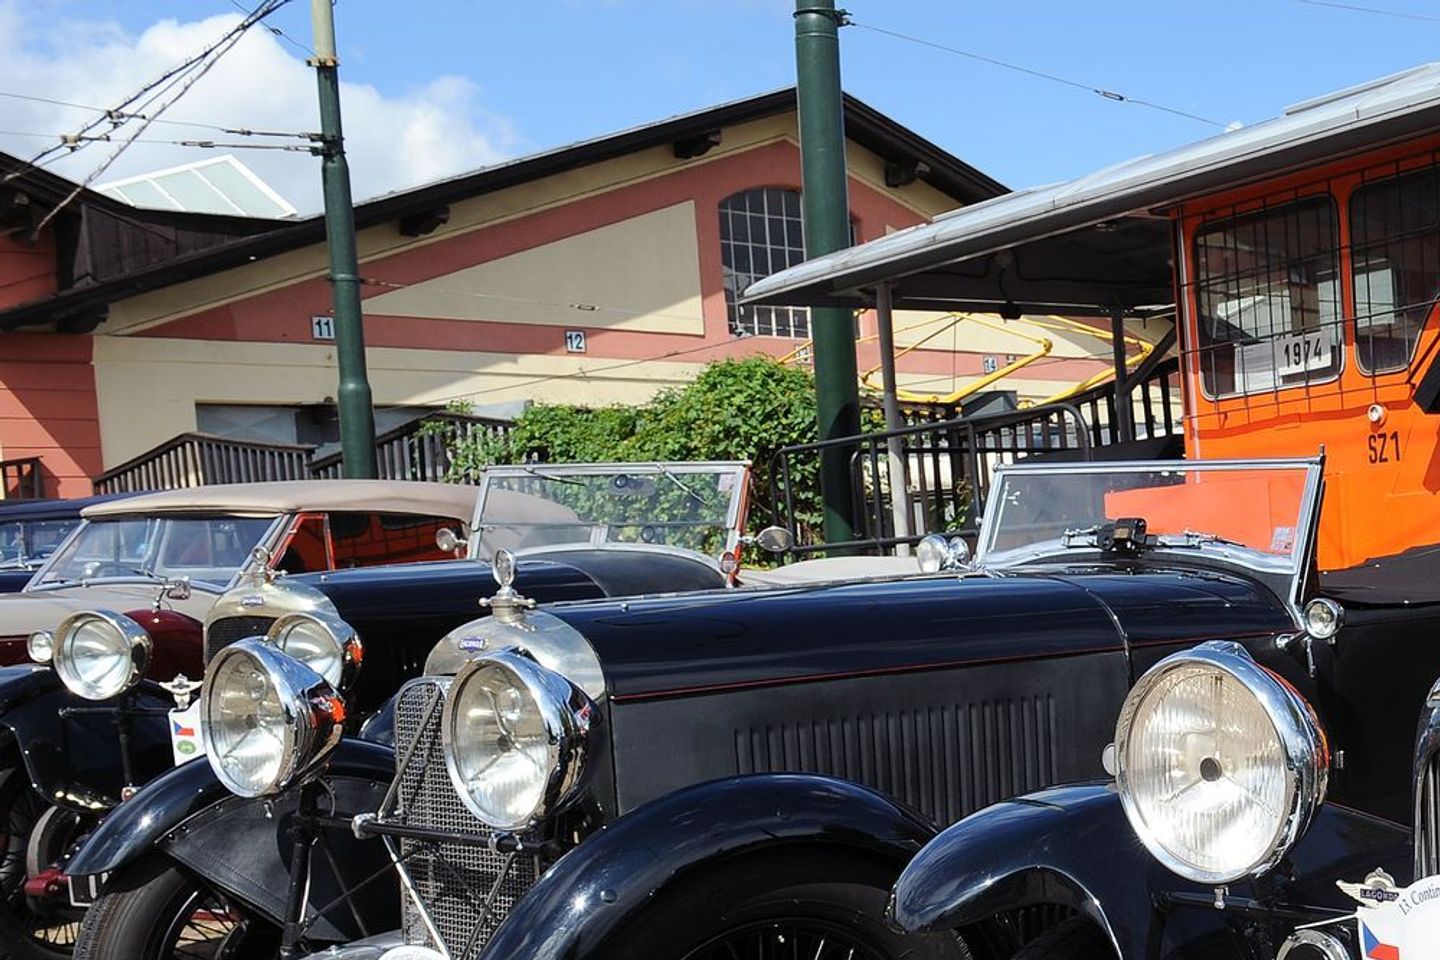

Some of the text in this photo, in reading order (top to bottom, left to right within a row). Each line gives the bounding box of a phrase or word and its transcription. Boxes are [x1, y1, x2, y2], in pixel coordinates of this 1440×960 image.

[315, 319, 334, 338] 11
[567, 333, 583, 350] 12
[1284, 338, 1322, 368] 1974
[983, 357, 997, 372] 14
[1360, 888, 1399, 901] LAGONDA
